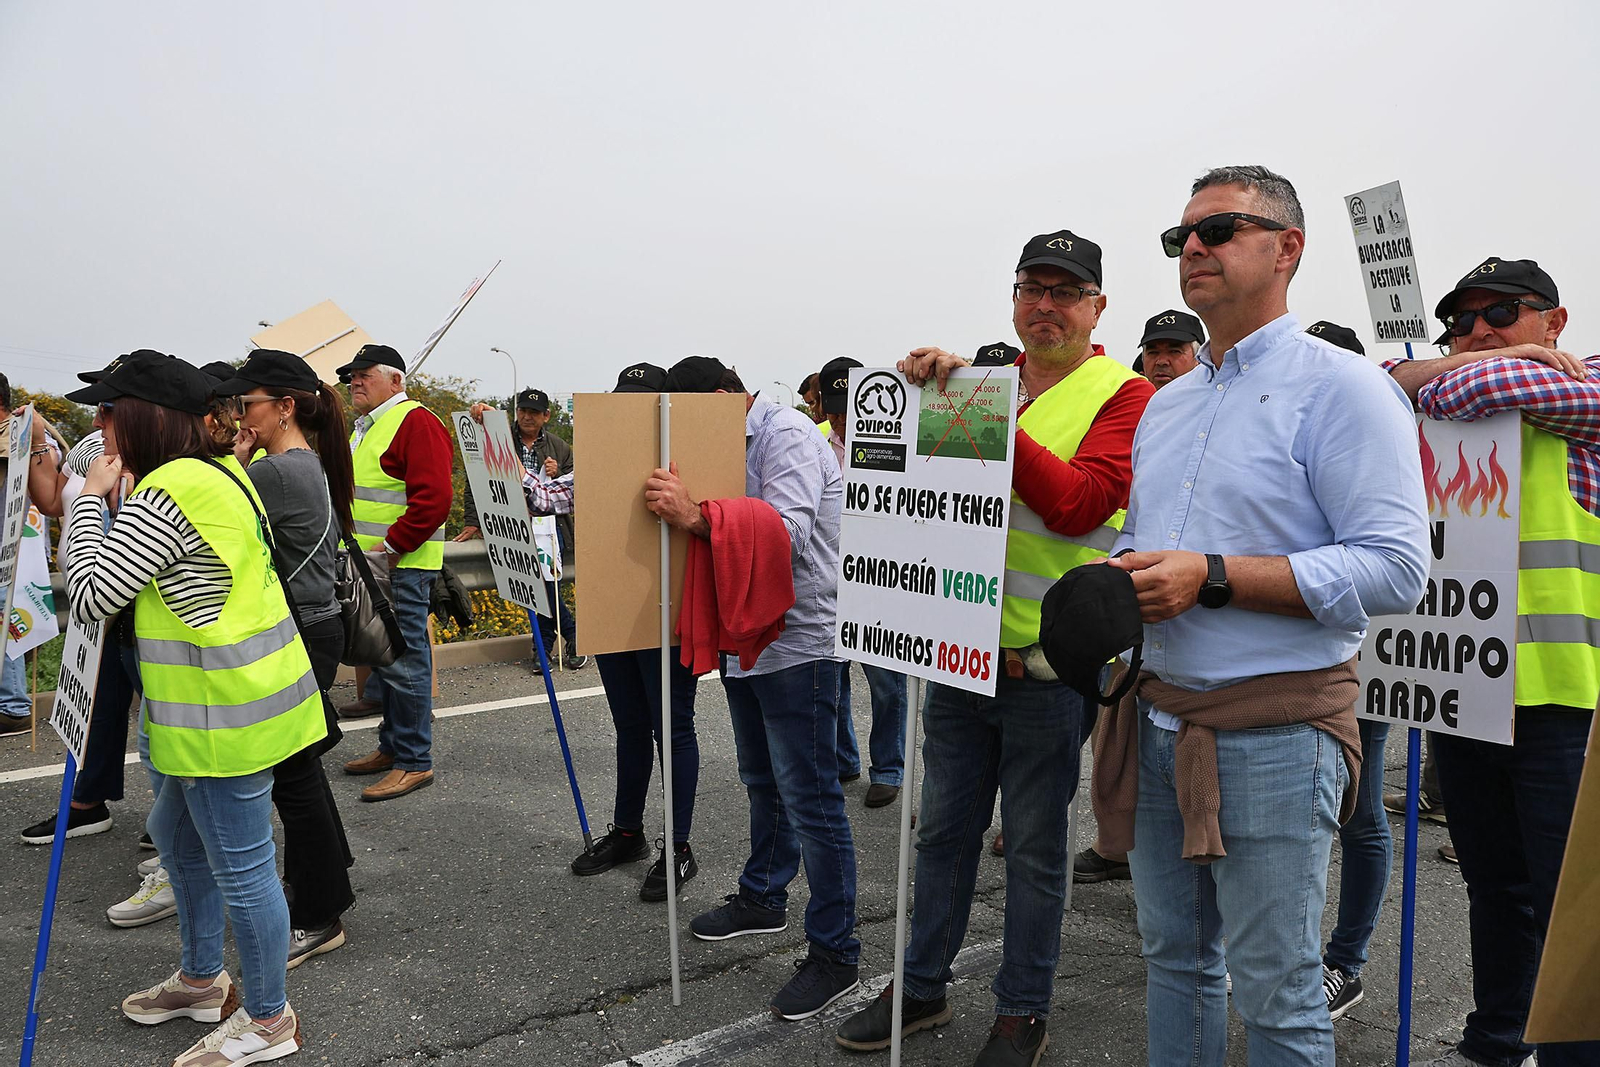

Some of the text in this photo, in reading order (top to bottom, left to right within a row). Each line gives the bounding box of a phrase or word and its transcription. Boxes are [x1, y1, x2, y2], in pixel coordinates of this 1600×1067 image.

[1373, 215, 1385, 234] LA
[1358, 236, 1413, 264] BUROCRACIA
[1369, 265, 1411, 289] DESTRUYE
[1389, 294, 1402, 313] LA
[1376, 314, 1426, 339] GANADERÍA
[856, 419, 902, 434] OVIPOR
[488, 479, 509, 506] SIN
[845, 481, 1004, 528] NO SE PUEDE TENER
[483, 512, 530, 545] GANADO
[488, 543, 503, 567] EL
[503, 546, 541, 580] CAMPO
[508, 577, 537, 609] ARDE
[842, 554, 998, 607] GANADERÍA VERDE
[1416, 577, 1499, 621] ADO
[76, 643, 88, 675] EN
[840, 620, 991, 681] EN NÚMEROS ROJOS
[1375, 628, 1509, 679] CAMPO
[58, 663, 92, 724] NUESTROS
[1366, 677, 1459, 729] ARDE
[54, 699, 85, 758] PUEBLOS
